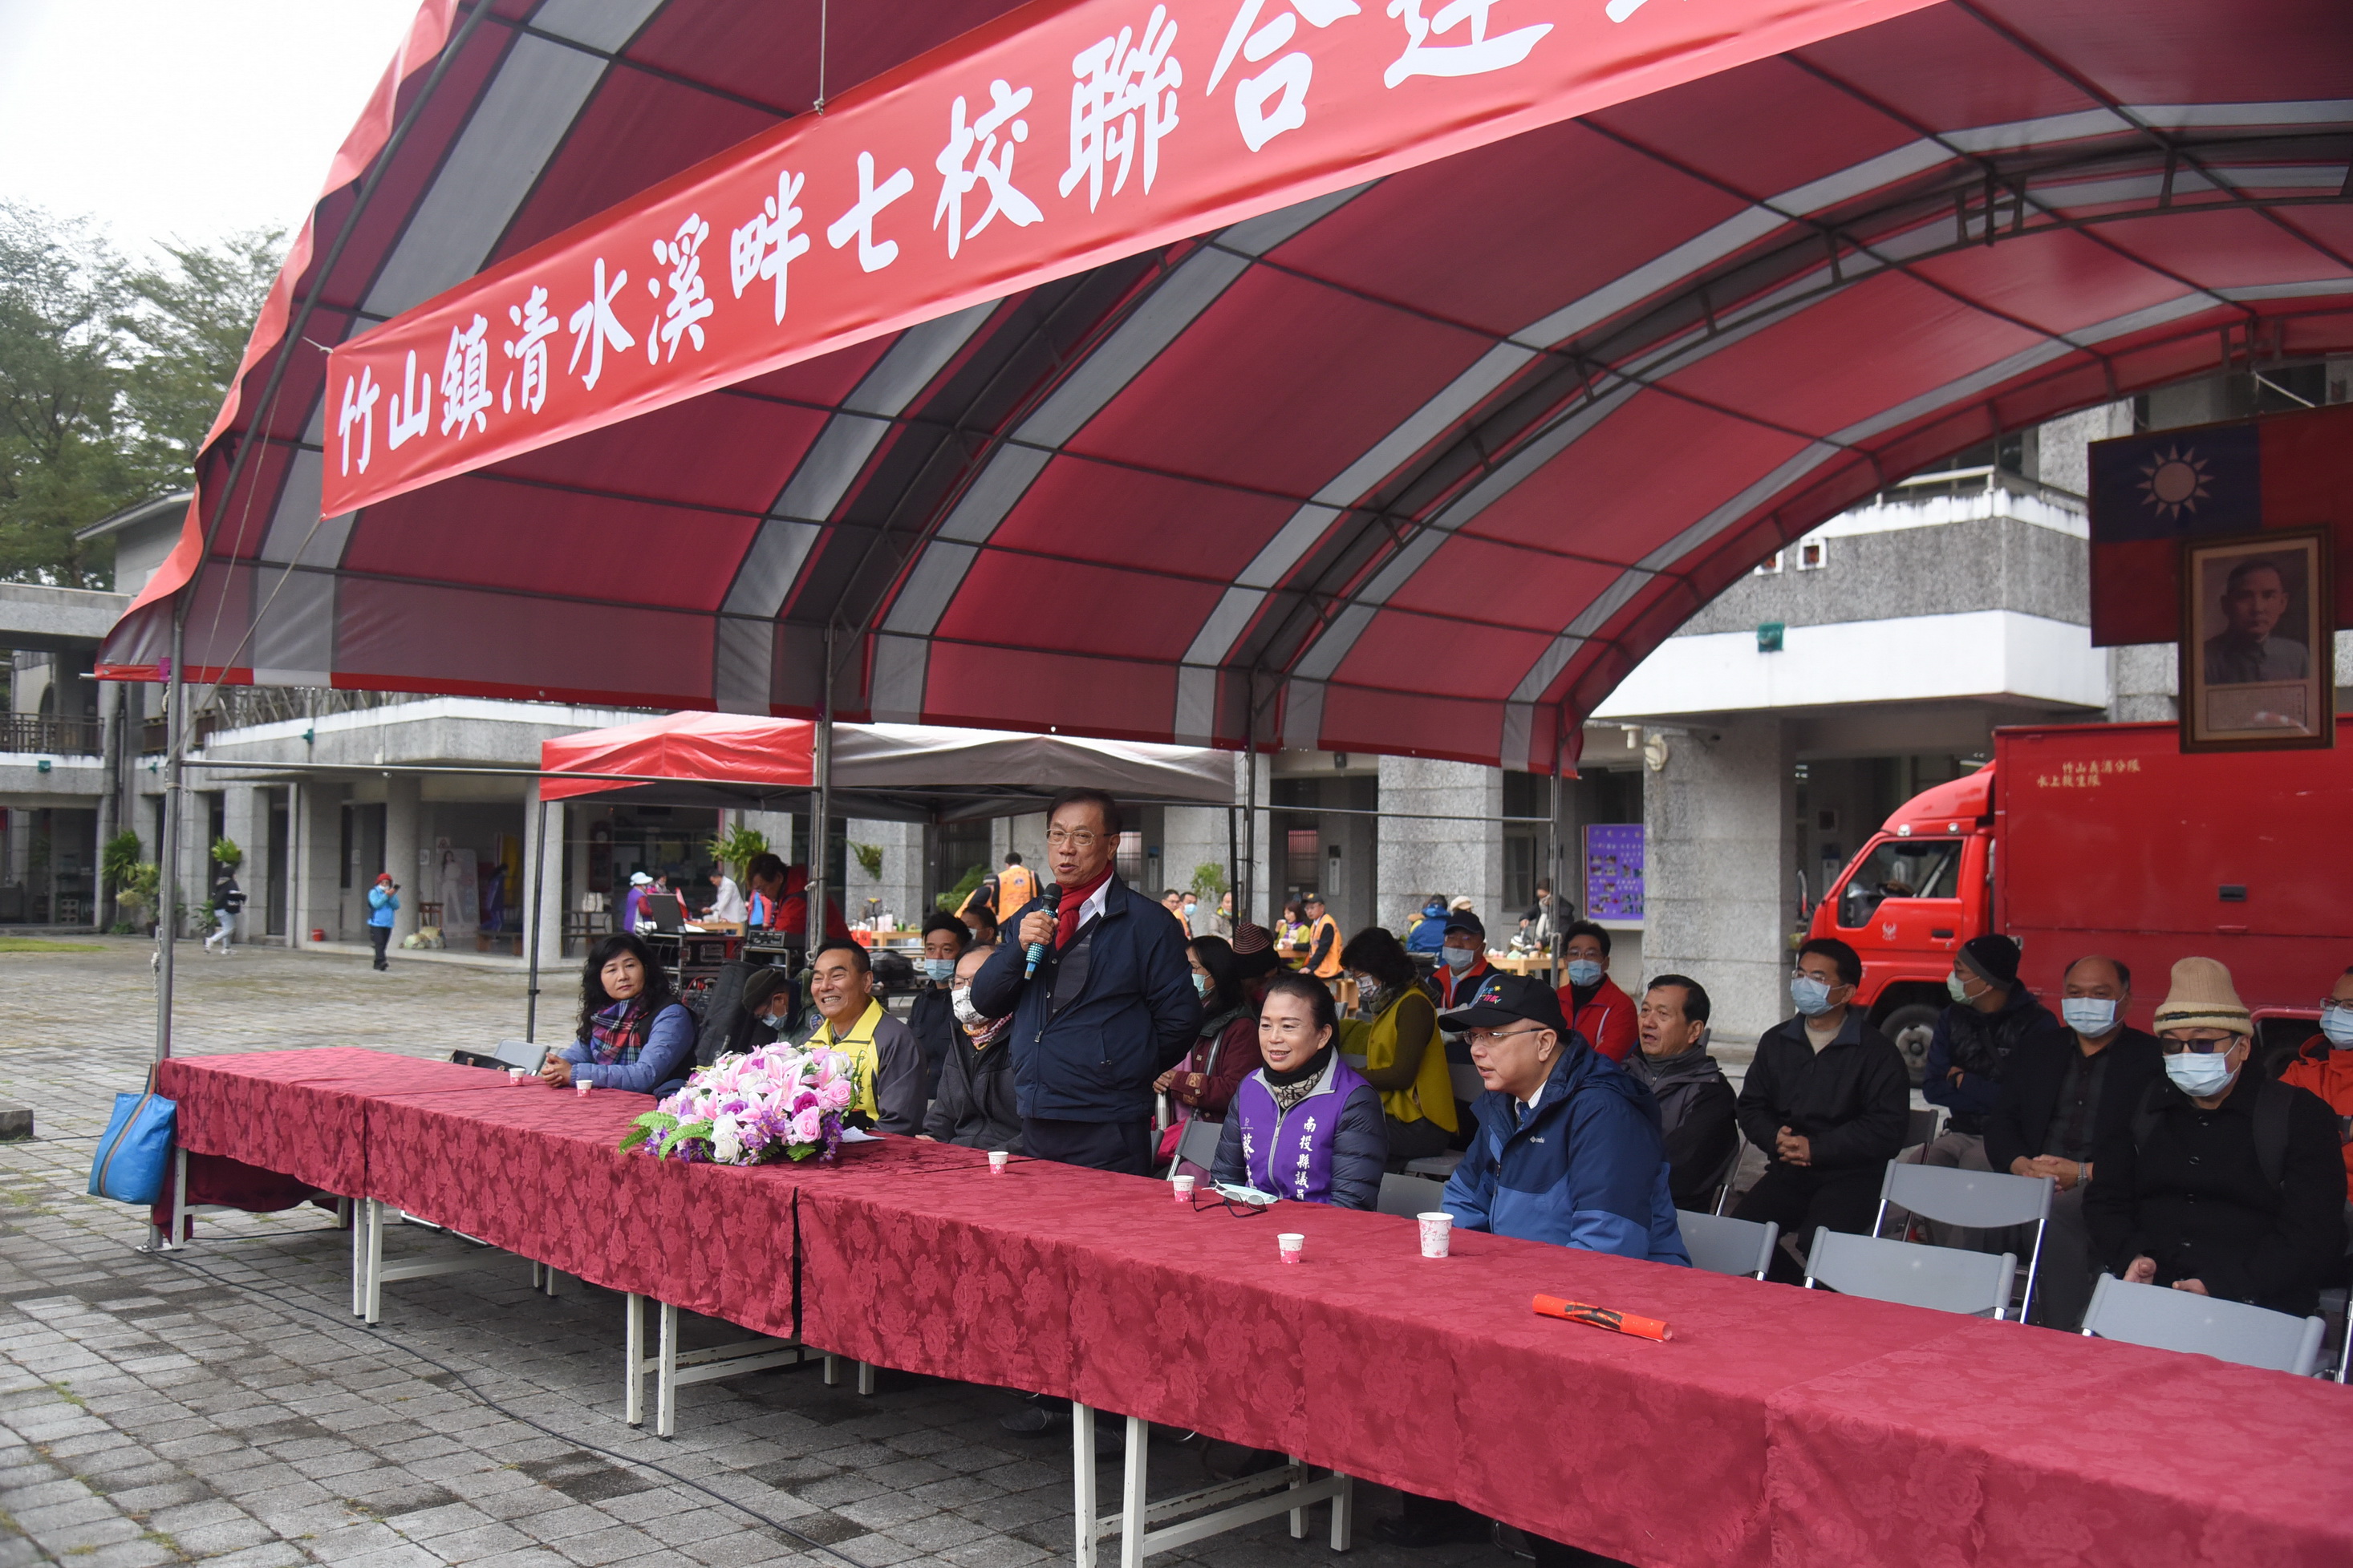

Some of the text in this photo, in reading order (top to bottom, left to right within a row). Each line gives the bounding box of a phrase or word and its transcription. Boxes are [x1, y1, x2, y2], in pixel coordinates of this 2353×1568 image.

[338, 0, 1689, 476] 竹山鎮清水溪畔七校聯合
[1294, 1116, 1316, 1201] 南投縣議員
